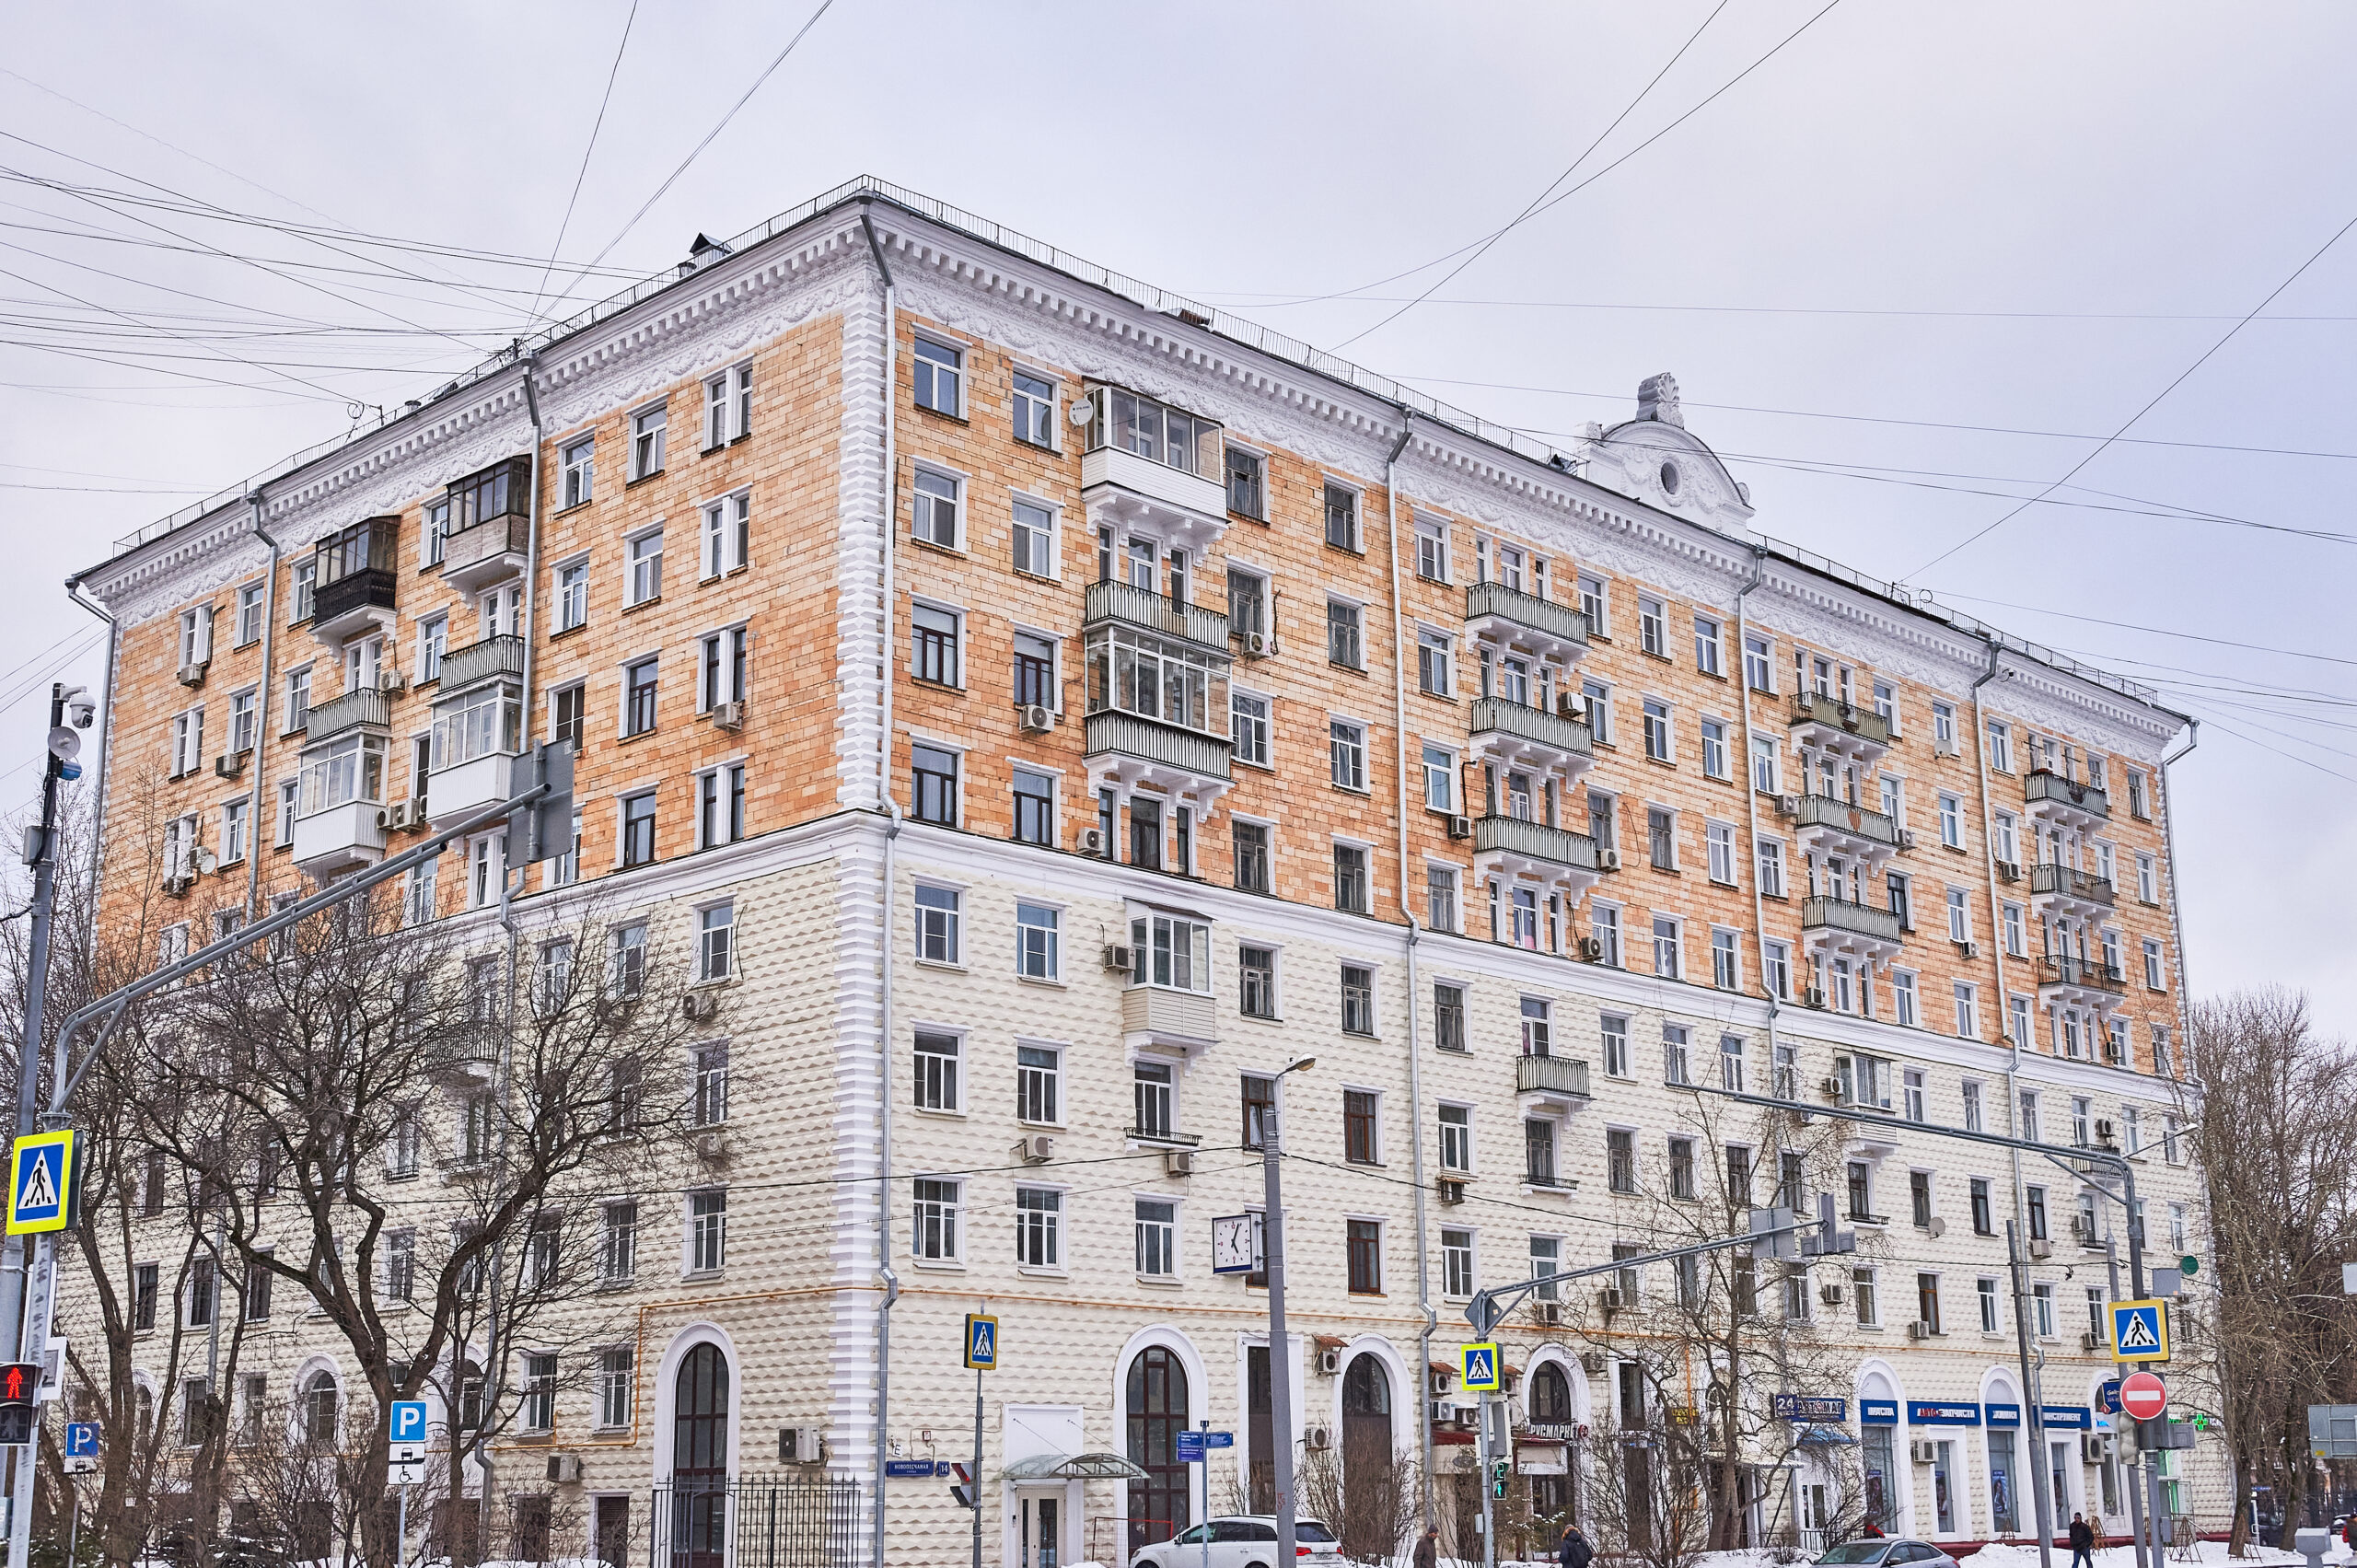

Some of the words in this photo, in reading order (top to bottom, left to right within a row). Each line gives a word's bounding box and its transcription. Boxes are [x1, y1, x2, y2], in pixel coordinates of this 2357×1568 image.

[1777, 1398, 1794, 1410] 24
[399, 1407, 420, 1436] P
[75, 1427, 92, 1452] P
[940, 1465, 948, 1473] 14
